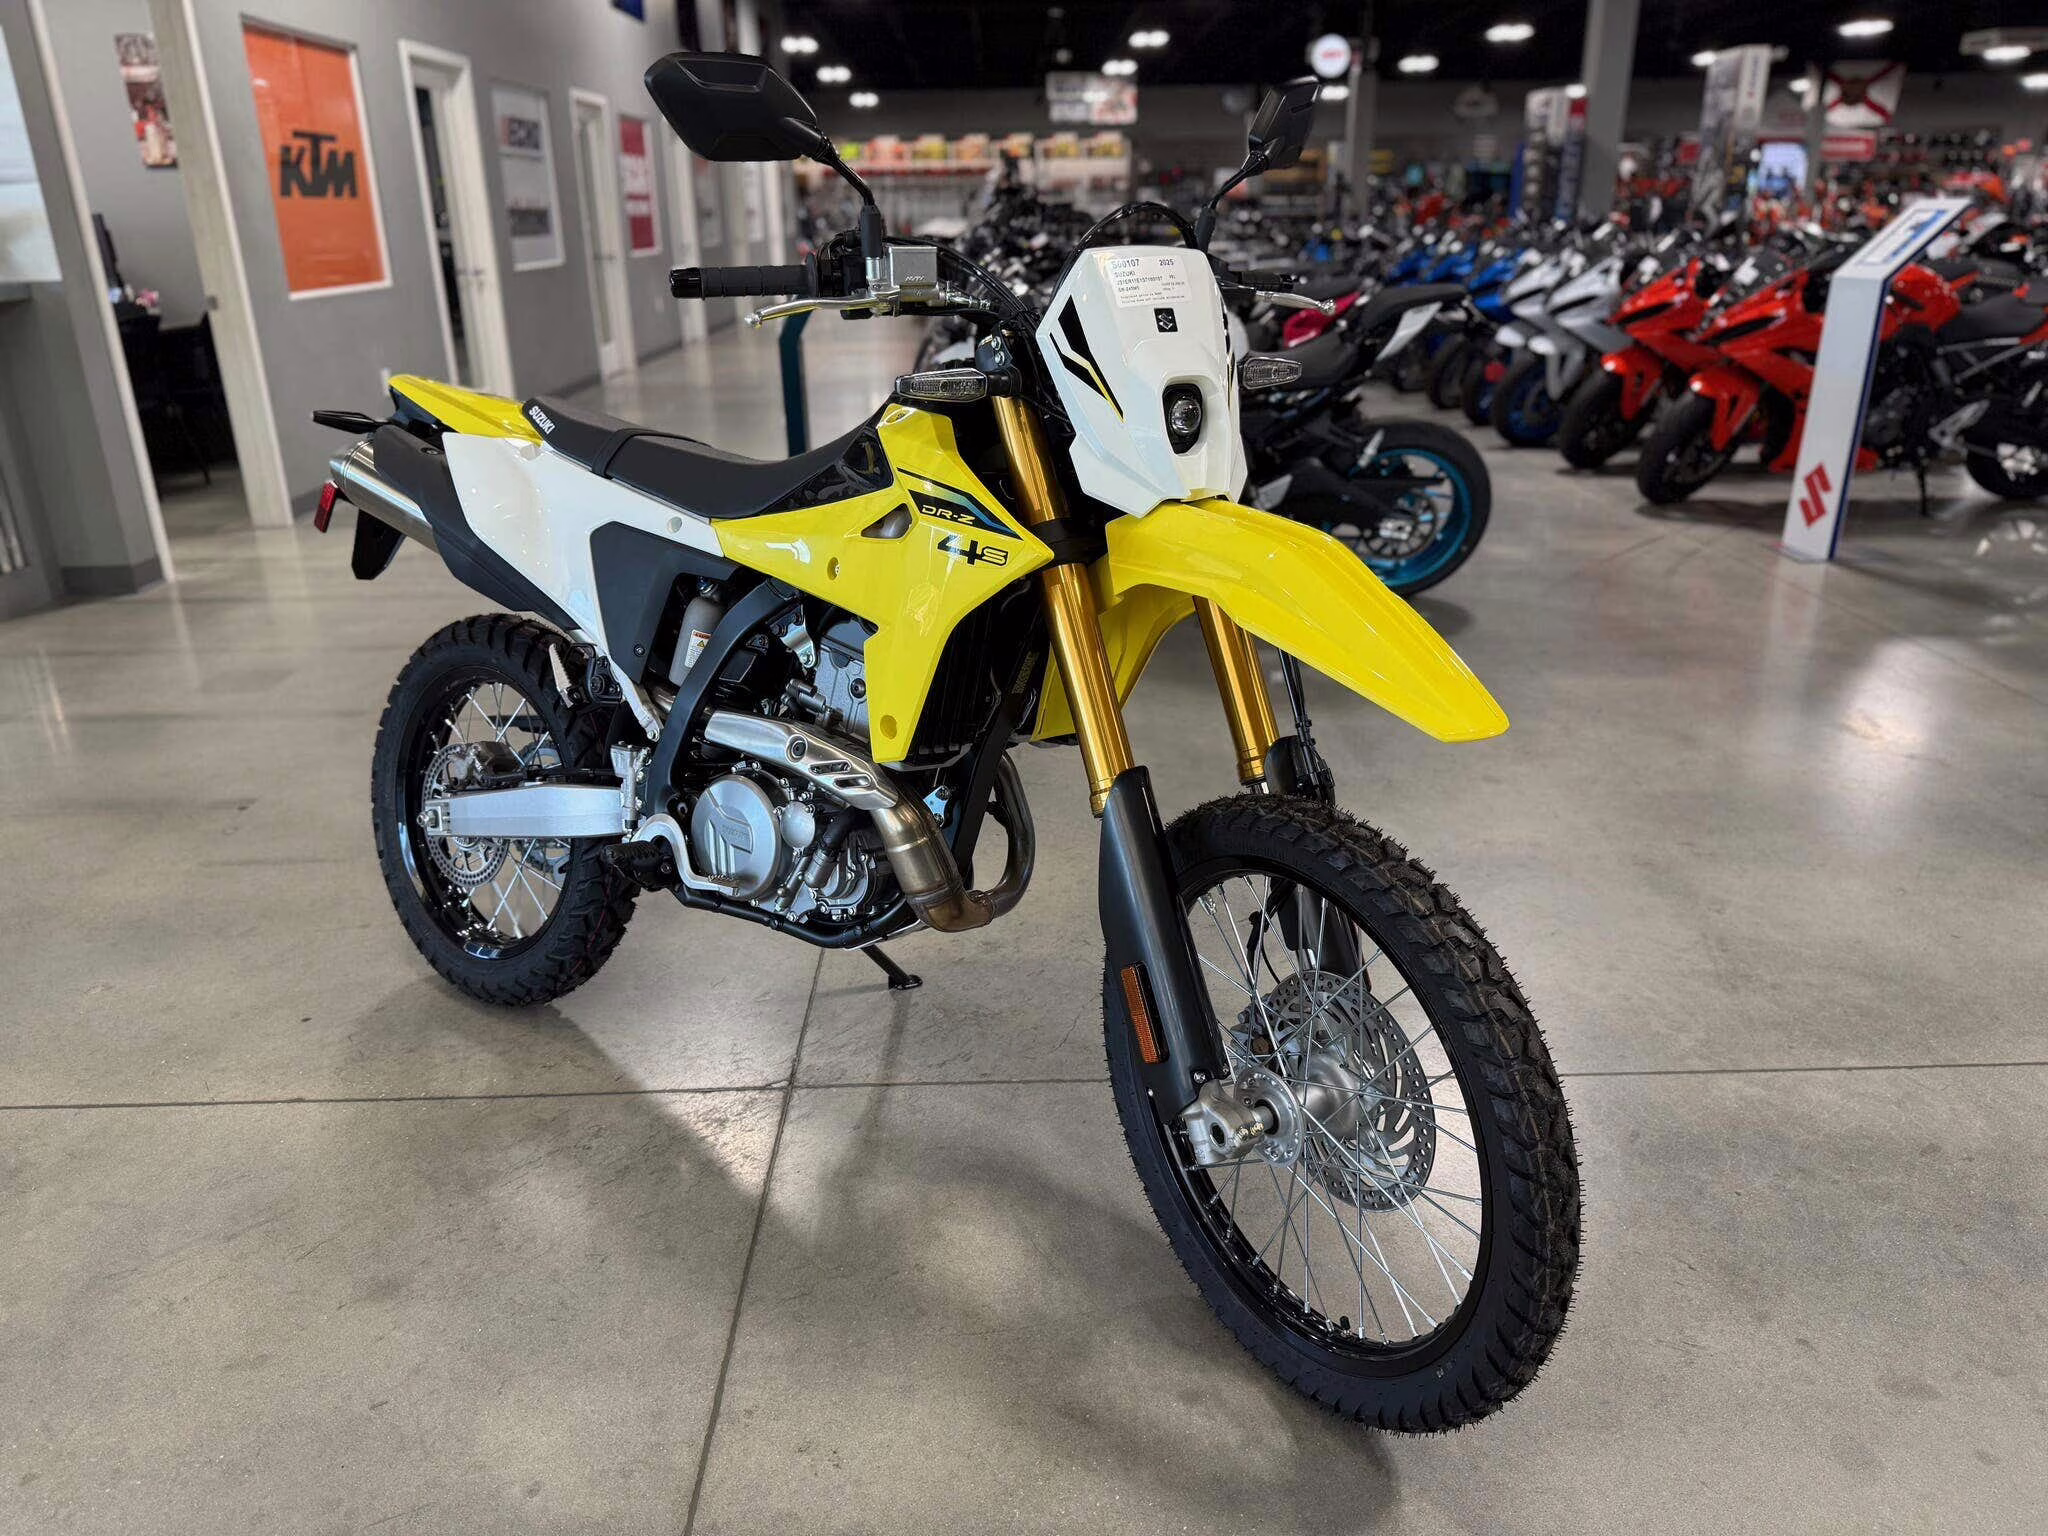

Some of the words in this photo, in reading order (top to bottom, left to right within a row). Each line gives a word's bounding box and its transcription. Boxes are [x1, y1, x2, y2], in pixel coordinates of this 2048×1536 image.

[280, 131, 357, 198] KTM
[1159, 258, 1174, 266] 2025
[529, 405, 556, 434] SUZUKI
[922, 504, 976, 525] DR-Z
